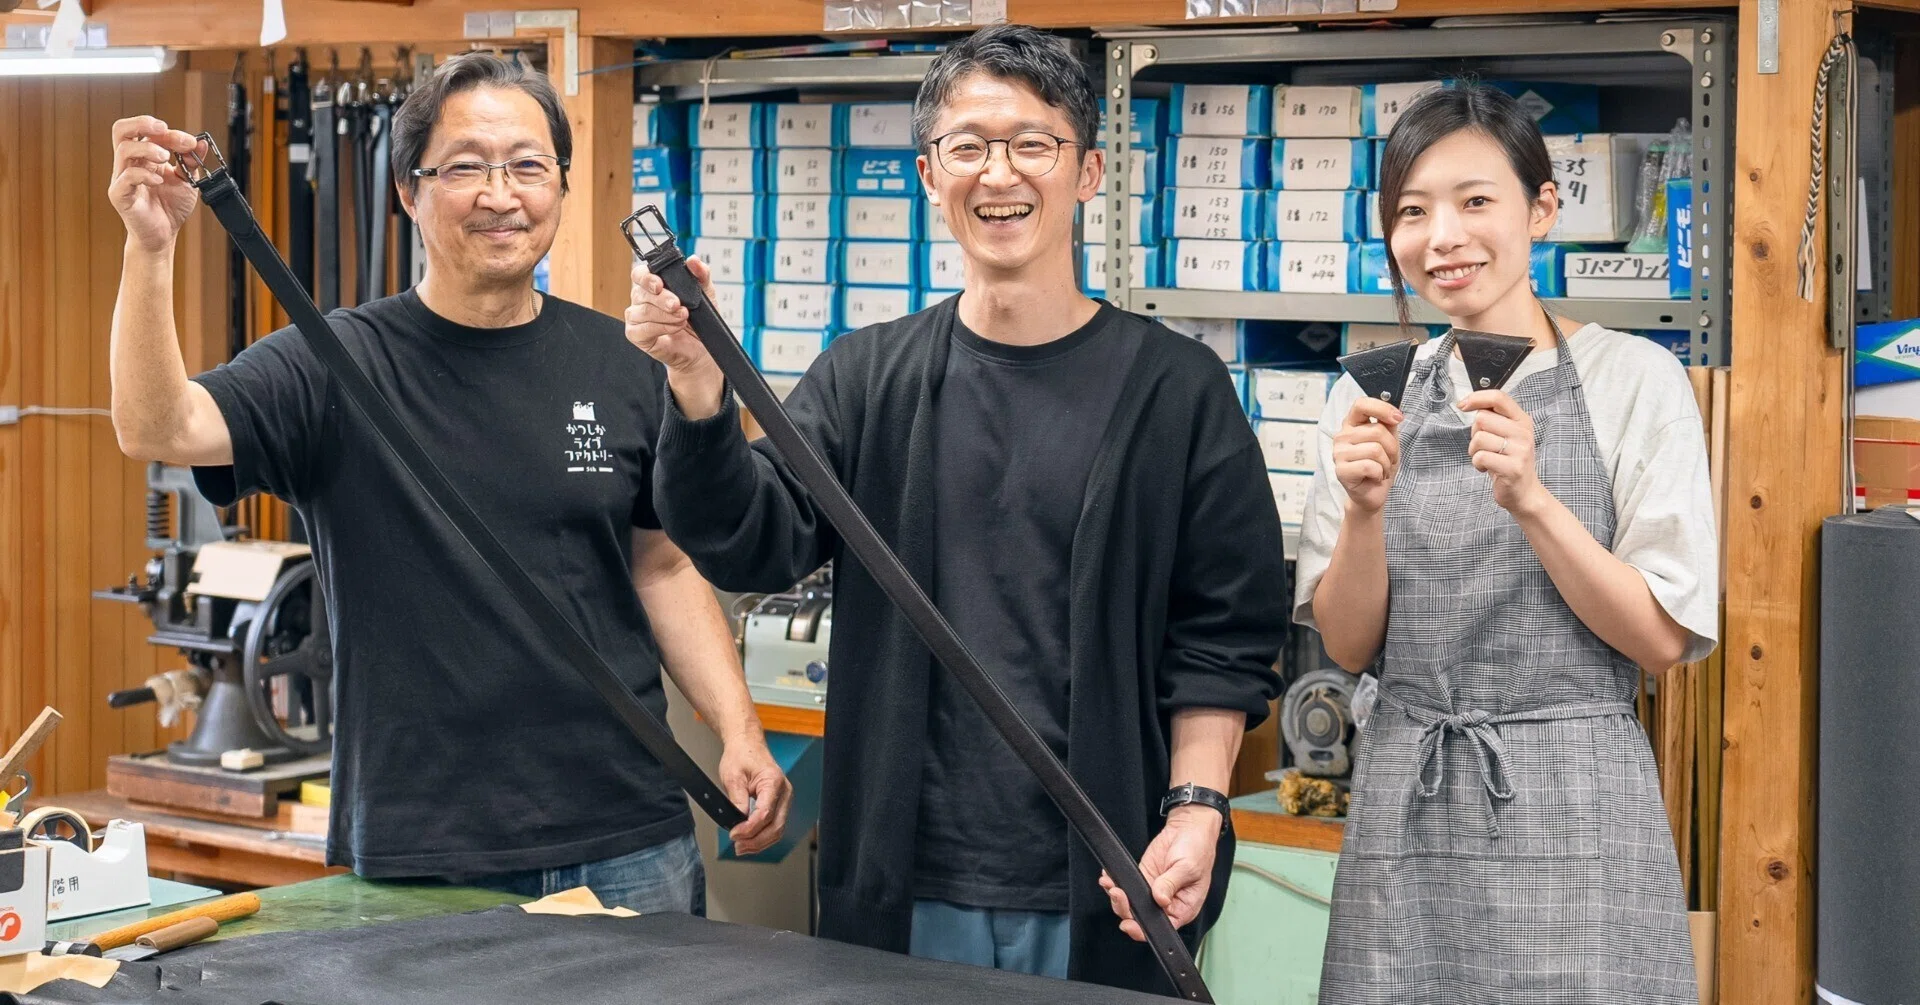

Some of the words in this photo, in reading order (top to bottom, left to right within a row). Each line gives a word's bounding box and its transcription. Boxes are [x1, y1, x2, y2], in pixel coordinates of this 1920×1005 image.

[1216, 104, 1235, 116] 156
[1318, 105, 1337, 115] 170
[1208, 147, 1228, 156] 150
[1207, 161, 1227, 170] 151
[1316, 159, 1336, 169] 171
[1206, 173, 1227, 184] 152
[1208, 197, 1229, 208] 153
[1207, 213, 1229, 223] 154
[1309, 211, 1328, 222] 172
[1205, 228, 1228, 238] 155
[1211, 260, 1230, 271] 157
[1315, 255, 1336, 265] 173
[566, 423, 606, 435] かつしか
[573, 436, 602, 449] ライブ
[564, 449, 613, 461] ファクトリー
